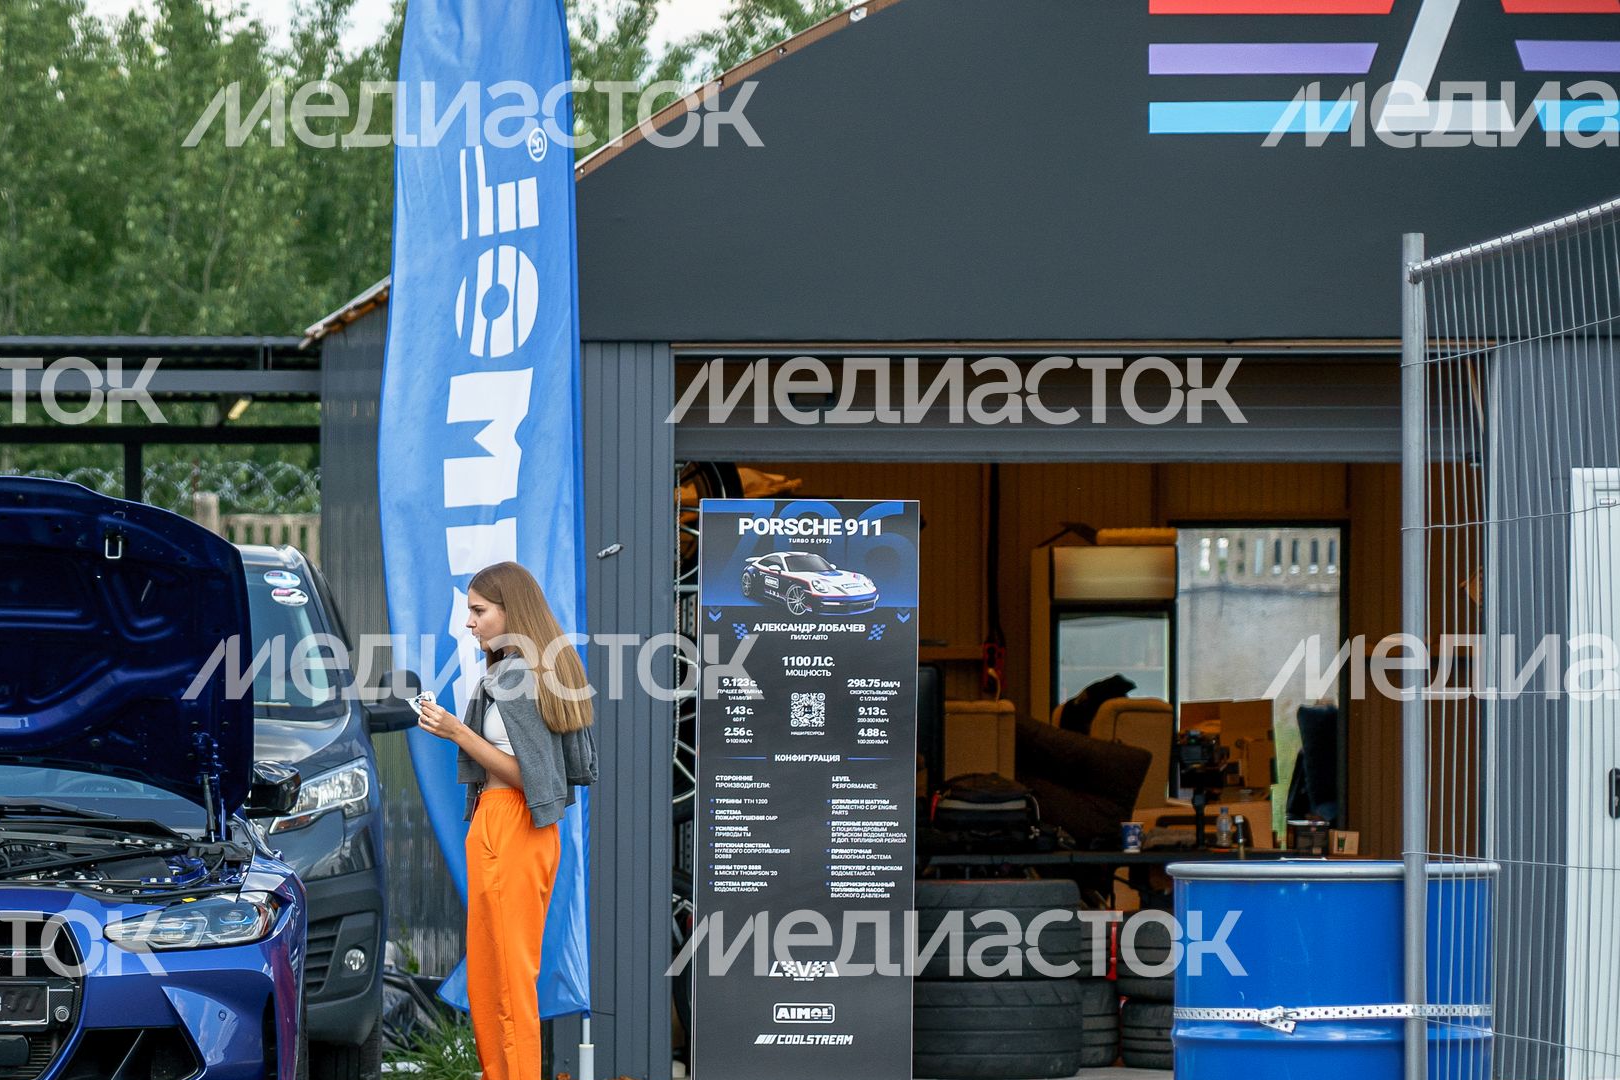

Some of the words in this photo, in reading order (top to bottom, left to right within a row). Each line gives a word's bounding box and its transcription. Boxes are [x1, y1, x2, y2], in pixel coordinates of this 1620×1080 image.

[738, 517, 842, 535] PORSCHE
[844, 518, 882, 536] 911
[816, 537, 832, 545] (992)
[753, 624, 816, 633] АЛЕКСАНДР
[817, 624, 866, 633] ЛОБАЧЕВ
[782, 656, 811, 667] 1100
[812, 656, 835, 667] Л.С.
[785, 669, 831, 677] МОЩНОСТЬ
[722, 678, 750, 687] 9.123
[847, 679, 880, 688] 298.75
[725, 706, 746, 715] 1.43
[858, 707, 880, 715] 9.13
[724, 727, 746, 736] 2.56
[857, 728, 879, 737] 4.88
[774, 754, 840, 763] КОНФИГУРАЦИЯ
[776, 1008, 832, 1019] AIMOL
[777, 1035, 853, 1045] COOLSTREAM
